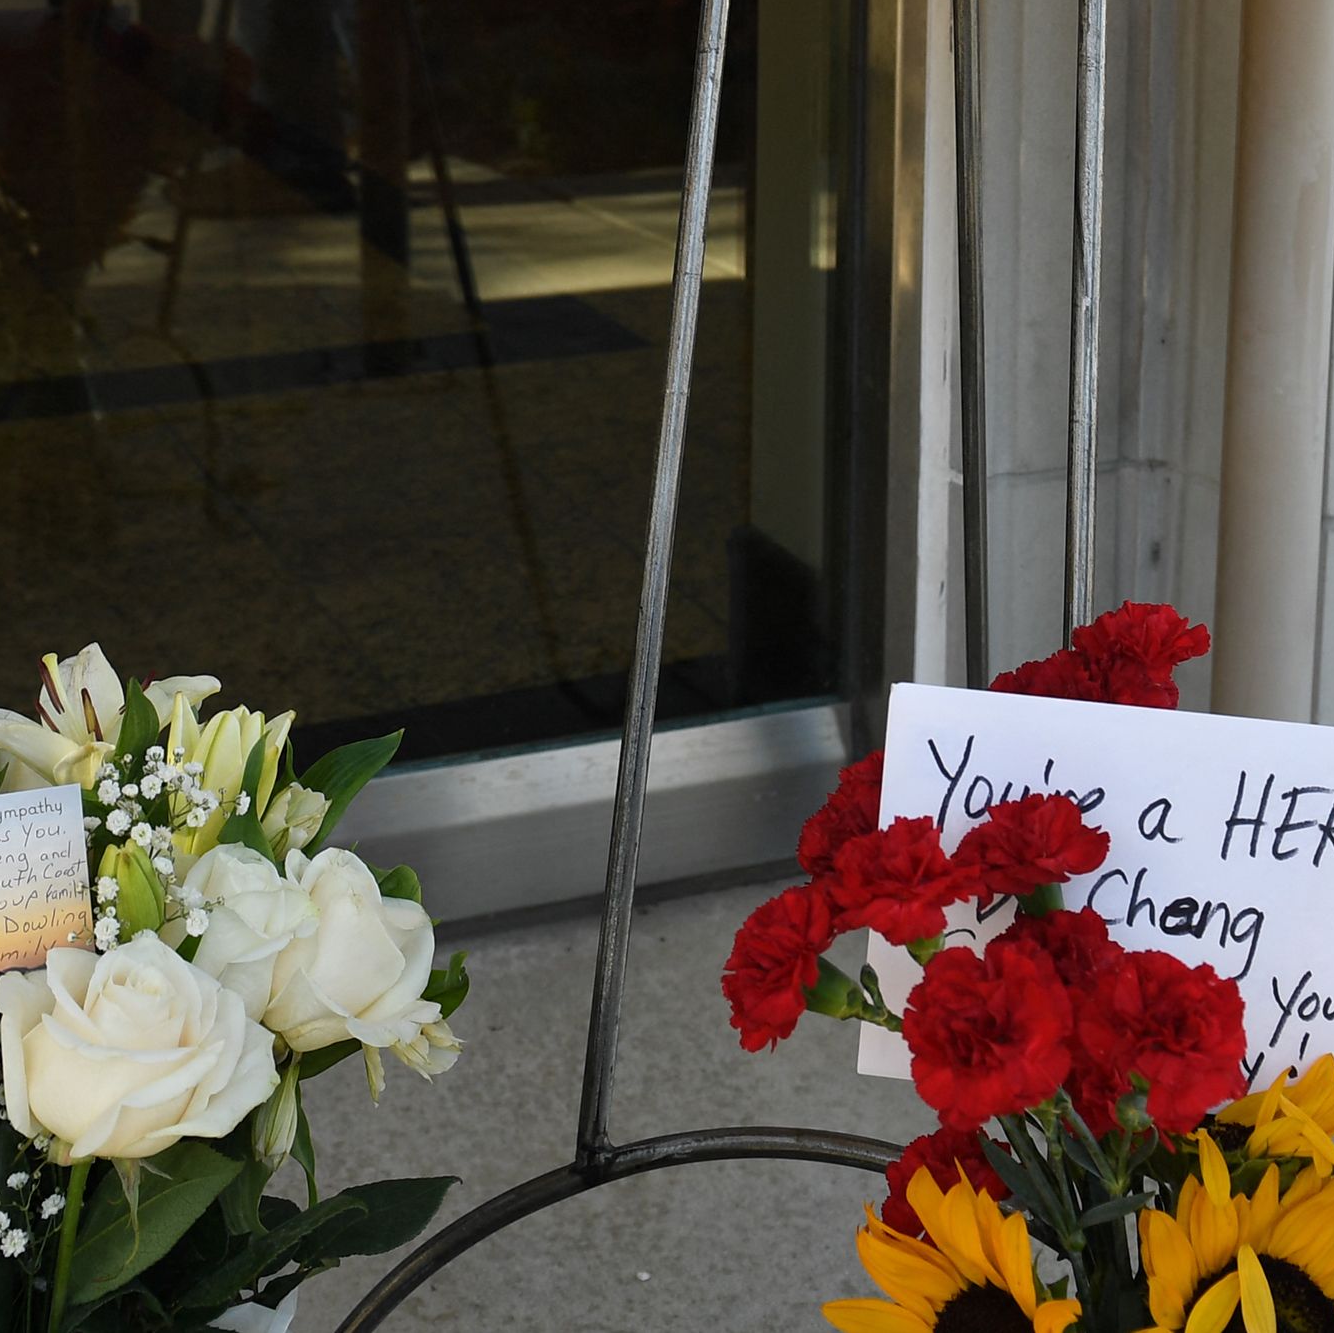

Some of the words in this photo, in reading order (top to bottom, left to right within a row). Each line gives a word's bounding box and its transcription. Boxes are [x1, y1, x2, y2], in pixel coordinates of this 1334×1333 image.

[1137, 797, 1184, 844] a
[40, 841, 71, 861] and
[43, 858, 86, 879] Coast
[4, 908, 88, 934] Dowling
